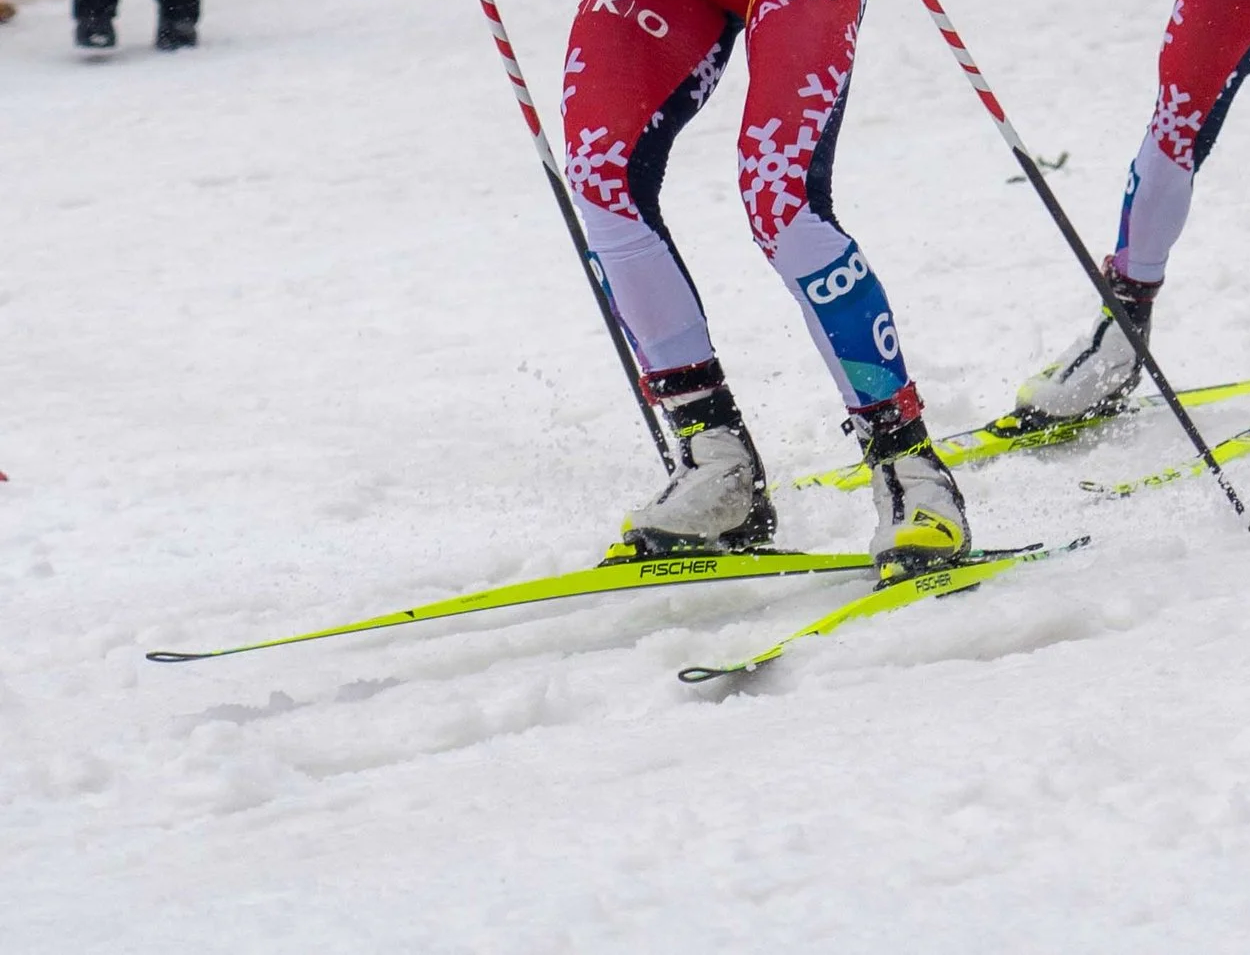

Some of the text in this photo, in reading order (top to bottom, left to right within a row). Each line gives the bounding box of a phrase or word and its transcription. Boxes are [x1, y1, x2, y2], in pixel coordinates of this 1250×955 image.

[872, 312, 898, 361] 6
[639, 560, 718, 579] FISCHER
[915, 572, 953, 594] FISCHER
